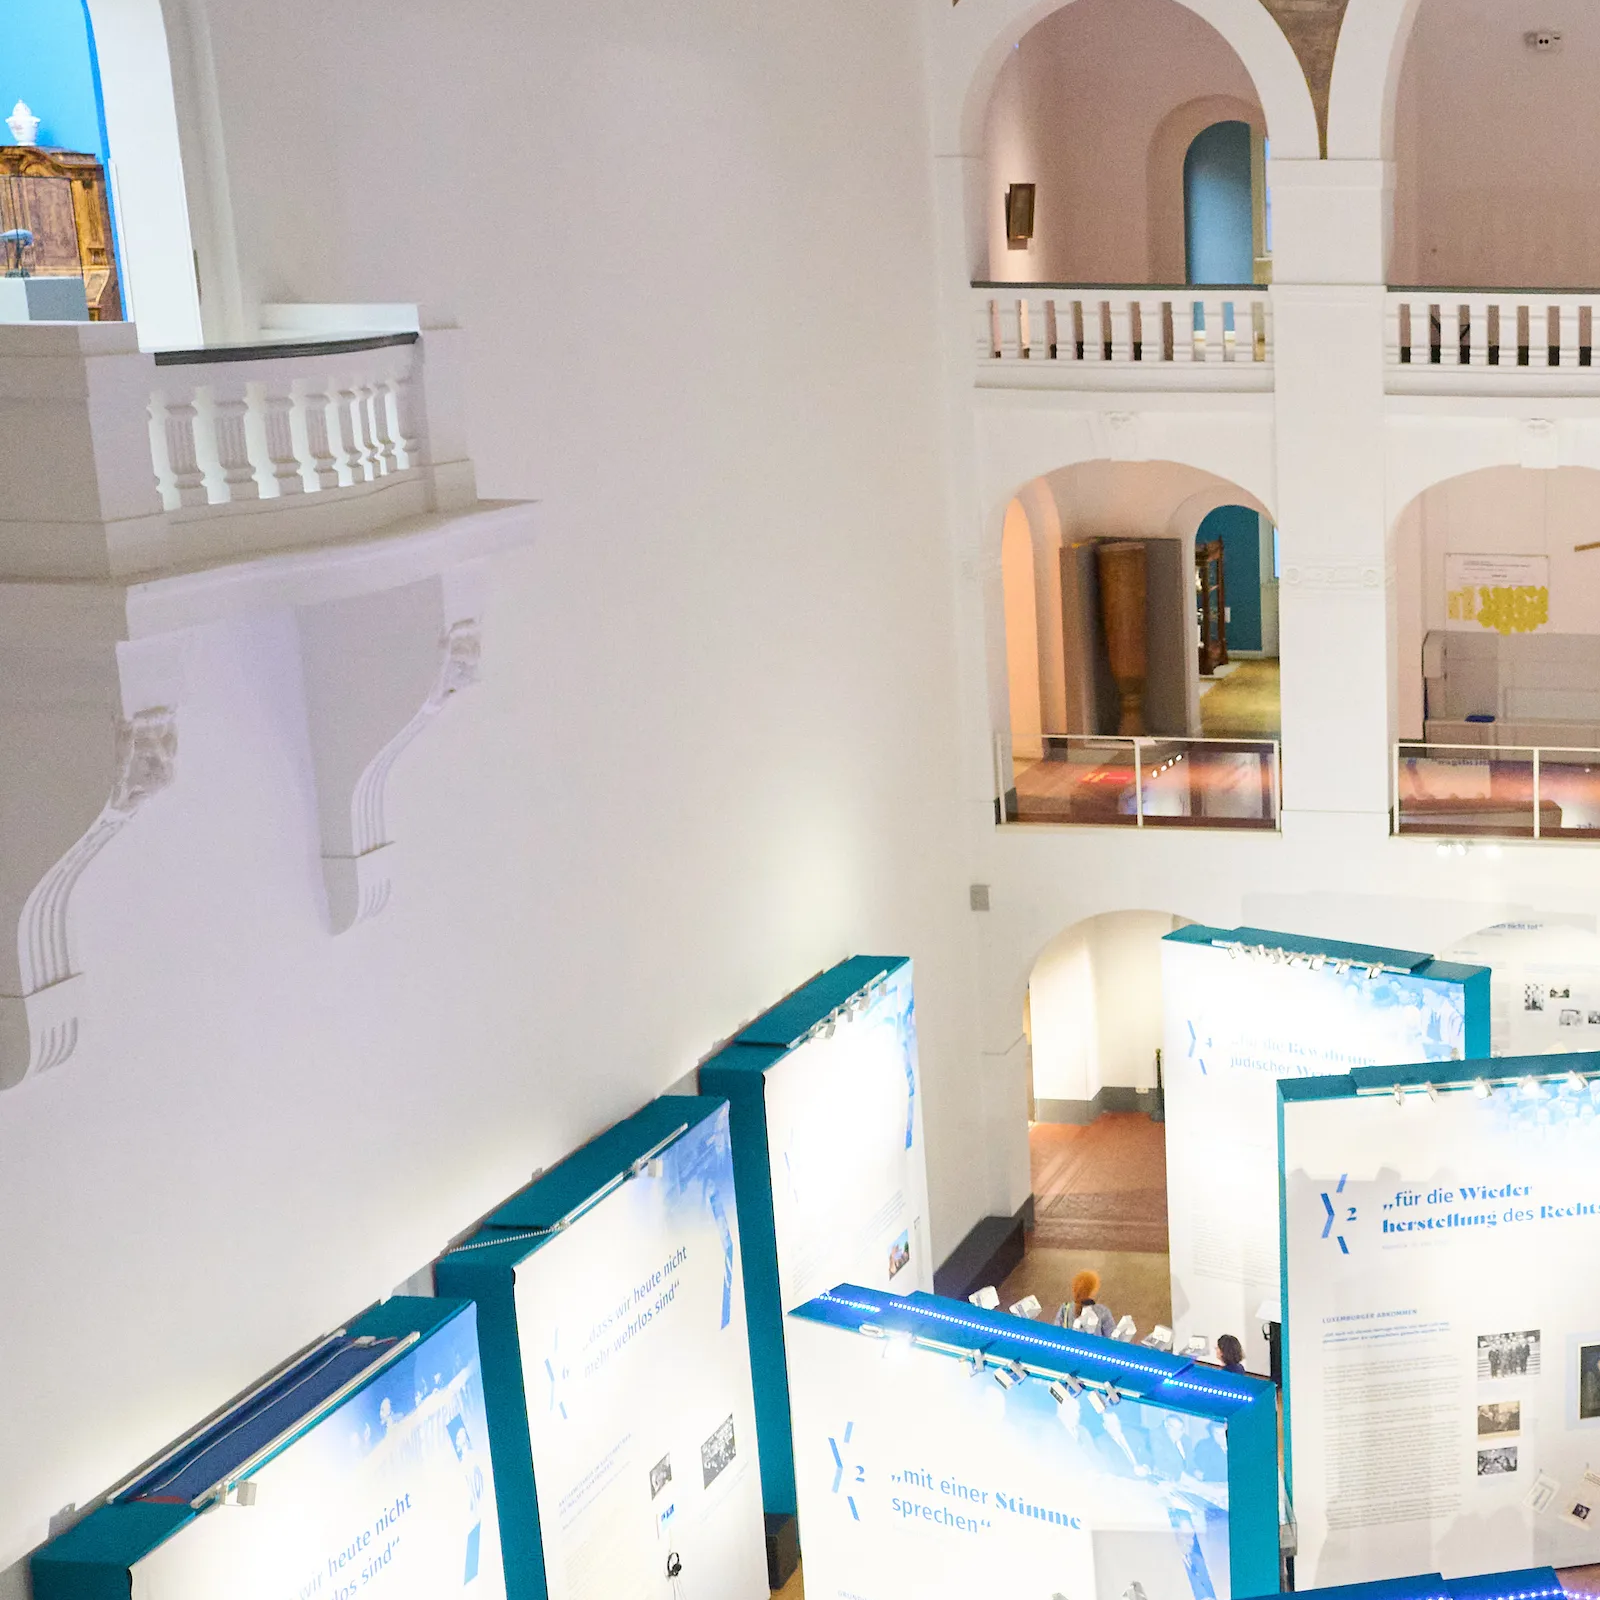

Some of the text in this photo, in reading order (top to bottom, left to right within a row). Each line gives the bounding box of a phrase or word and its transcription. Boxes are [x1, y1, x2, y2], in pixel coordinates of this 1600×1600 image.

[1346, 1207, 1357, 1221] 2
[1382, 1184, 1533, 1211] „für die Wieder
[1382, 1214, 1497, 1234] herstellung
[1503, 1208, 1534, 1223] des
[616, 1296, 630, 1319] wir
[634, 1271, 661, 1303] heute
[663, 1246, 686, 1276] nicht
[584, 1279, 679, 1378] mehr wehrlos sind“
[855, 1465, 865, 1483] 2
[891, 1468, 1081, 1530] „mit einer Stimme
[892, 1497, 991, 1533] sprechen“
[328, 1530, 371, 1577] heute
[375, 1493, 412, 1535] nicht
[361, 1536, 400, 1585] sind“
